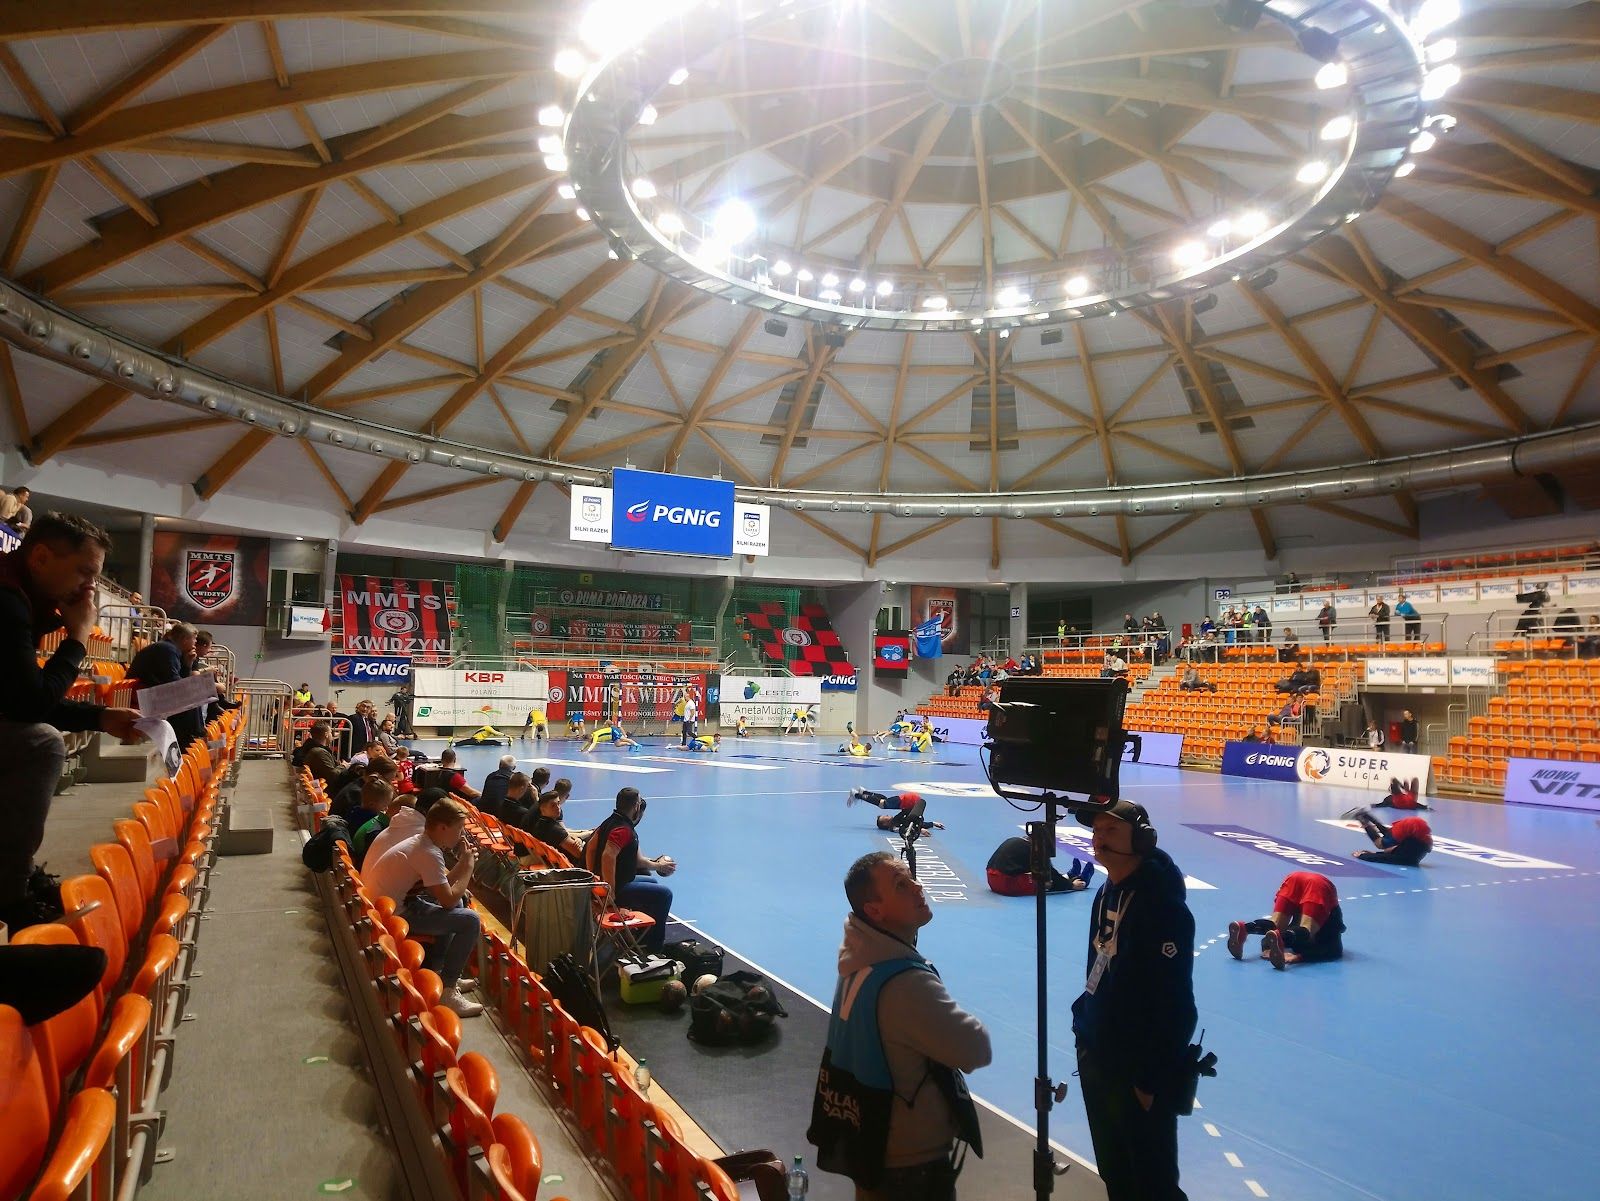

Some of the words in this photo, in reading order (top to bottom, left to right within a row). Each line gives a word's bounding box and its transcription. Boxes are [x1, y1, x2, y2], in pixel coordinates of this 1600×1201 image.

[652, 505, 721, 527] PGNiG
[191, 552, 232, 561] MMTS
[347, 591, 442, 610] MMTS
[576, 590, 602, 605] DUMA
[606, 591, 647, 608] POMORZA
[1011, 608, 1019, 617] B2
[560, 626, 607, 635] MMTS
[611, 628, 682, 638] KWIDZYN
[348, 635, 446, 651] KWIDZYN
[354, 662, 409, 676] PGNiG
[465, 672, 504, 683] KBR
[603, 673, 651, 681] WARTOŚCIACH
[821, 675, 856, 685] PGNiG
[1258, 754, 1295, 768] PGNiG
[1338, 756, 1389, 771] SUPER
[1343, 772, 1379, 781] LIGA
[1532, 768, 1581, 782] NOWA
